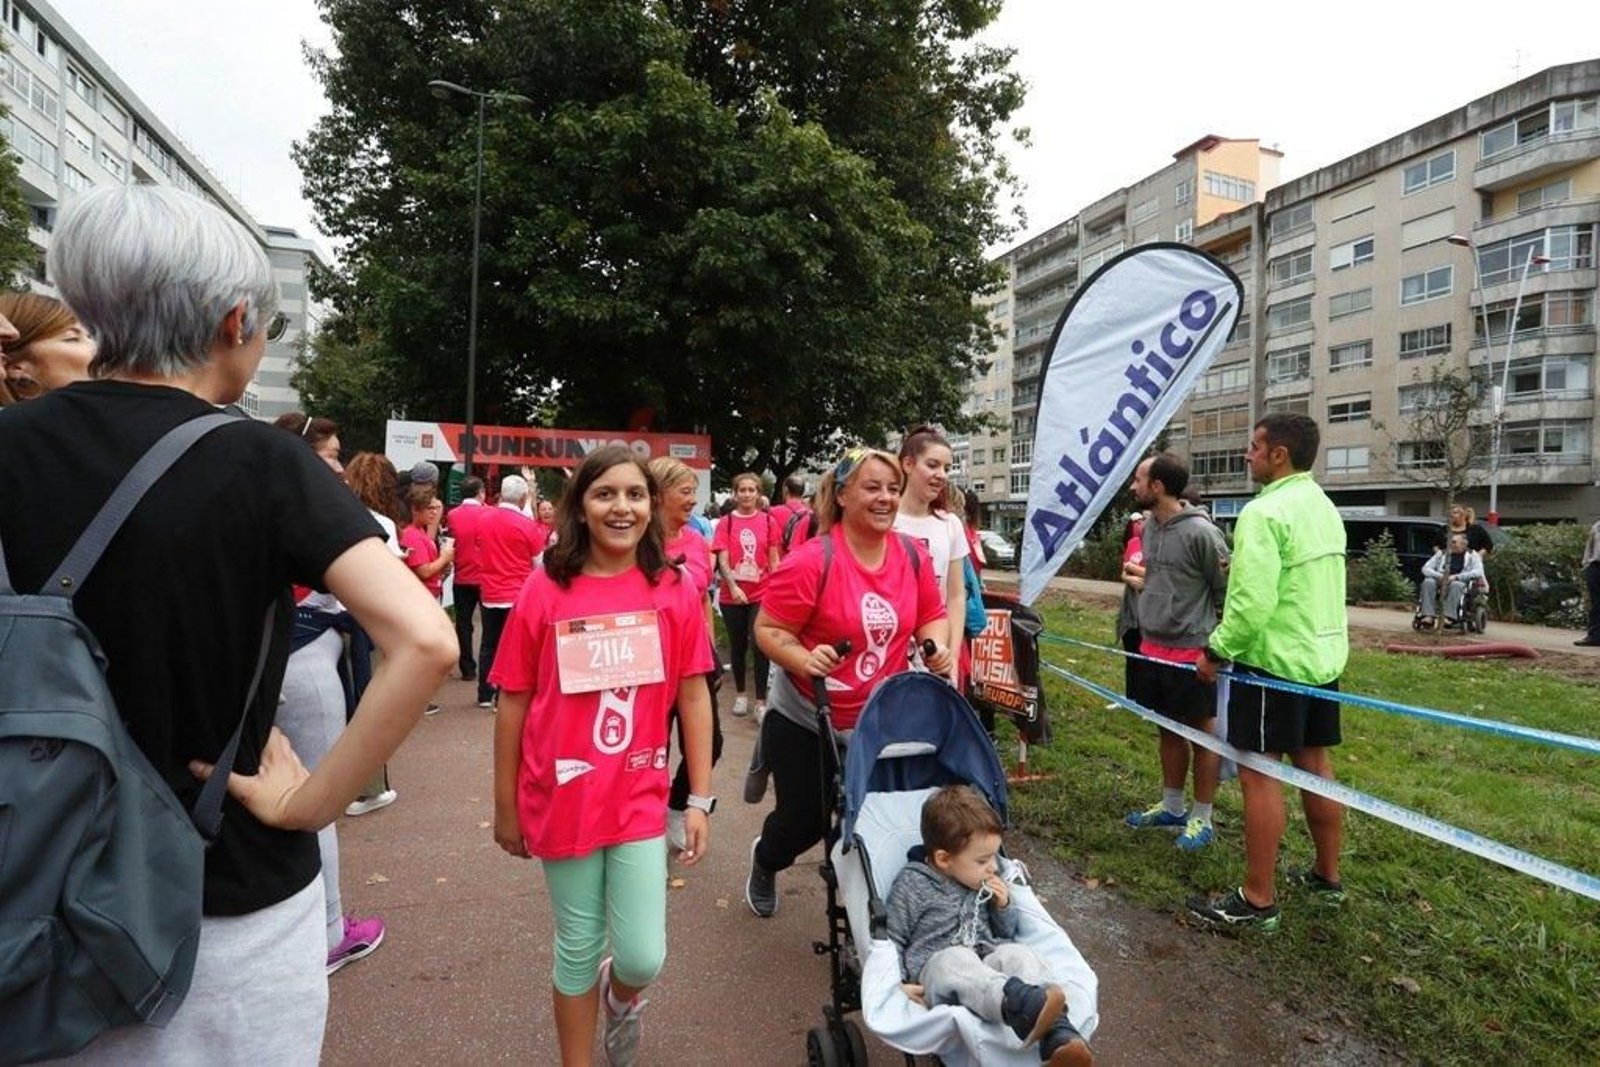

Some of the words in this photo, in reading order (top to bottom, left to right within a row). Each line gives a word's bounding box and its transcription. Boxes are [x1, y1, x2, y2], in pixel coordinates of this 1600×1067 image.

[1030, 288, 1218, 564] Atlántico
[588, 636, 635, 669] 2114
[976, 638, 1005, 660] THE
